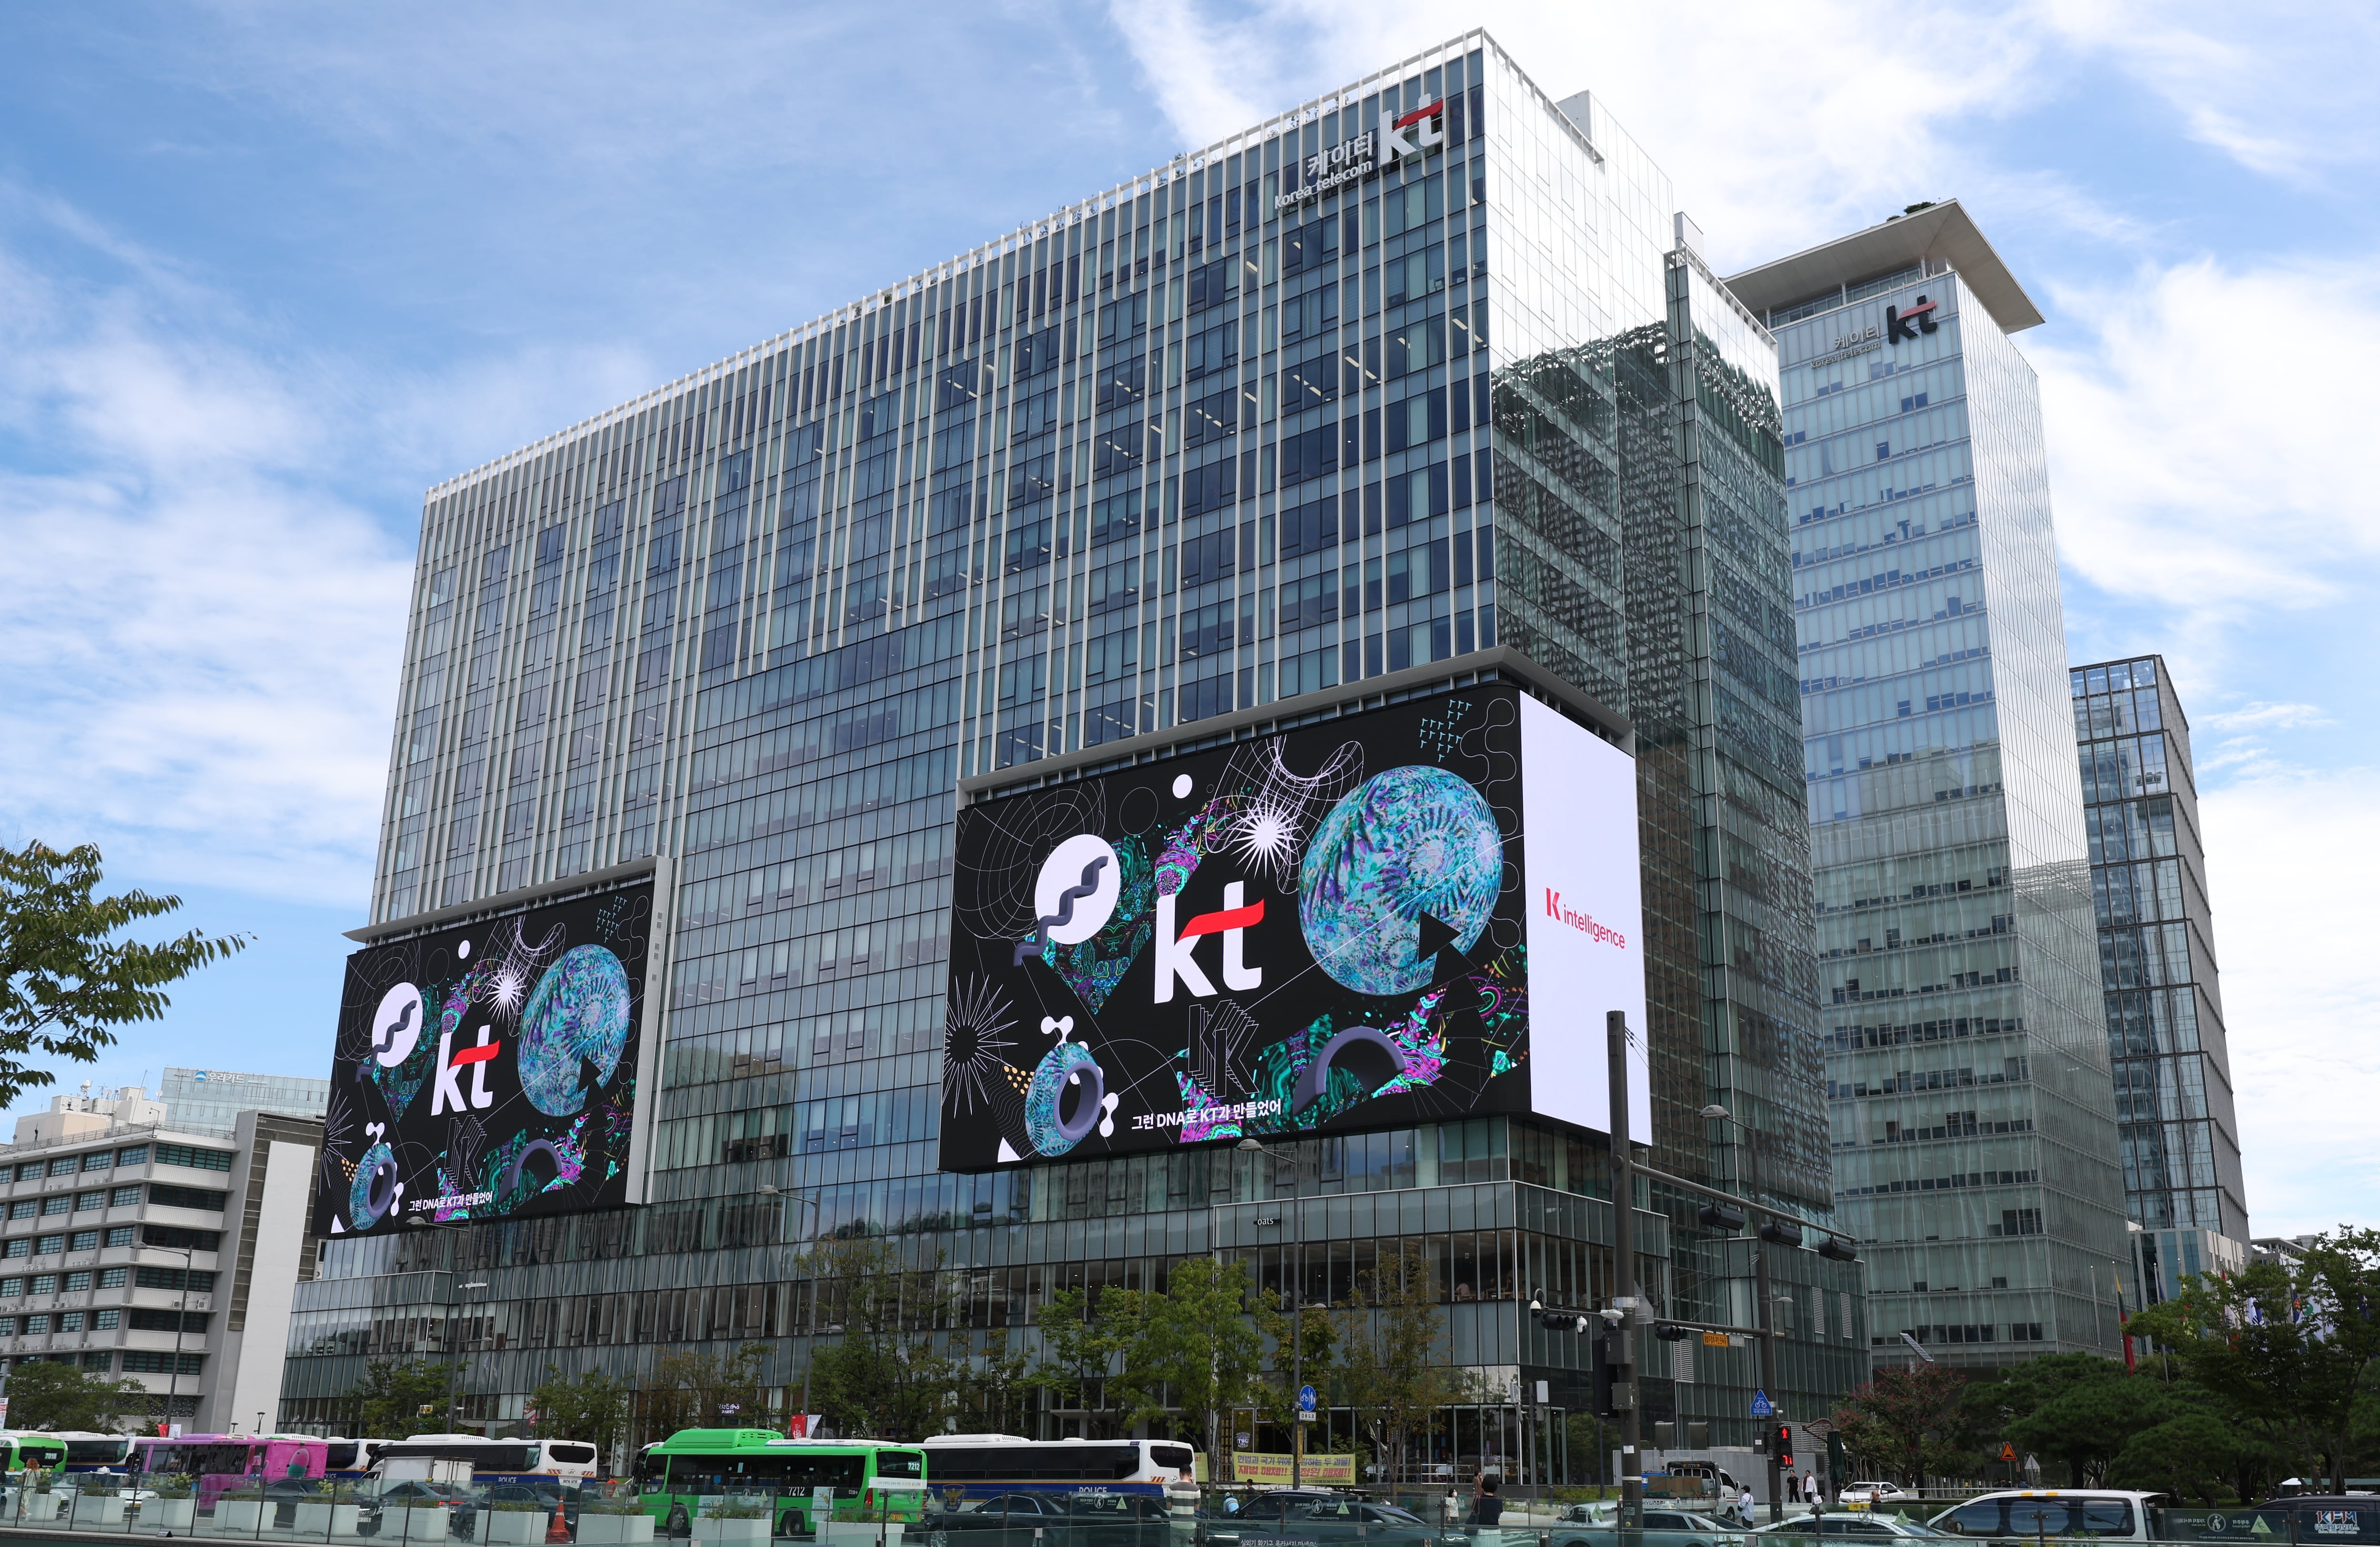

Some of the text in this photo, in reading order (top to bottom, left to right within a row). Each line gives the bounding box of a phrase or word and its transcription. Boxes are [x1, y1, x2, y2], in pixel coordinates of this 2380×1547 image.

[1379, 93, 1444, 167] kt
[1308, 131, 1372, 177] 케이티
[1275, 161, 1372, 209] korea telecom
[1886, 295, 1938, 345] kt
[1834, 323, 1880, 349] 케이티
[1810, 342, 1881, 369] korea telecom
[1546, 887, 1625, 949] K intelligence
[1154, 880, 1265, 1005] kt
[208, 1072, 245, 1084] 우리카드
[431, 1024, 500, 1116] kt
[1131, 1098, 1281, 1130] 그런 DNA로 KT가 만들었어
[408, 1191, 493, 1212] 그런 DNA로 KT가 만들었어
[1258, 1217, 1274, 1225] oats
[1237, 1455, 1259, 1464] 헌법과
[1260, 1456, 1275, 1465] 국가
[1277, 1457, 1292, 1465] 위에
[1324, 1458, 1331, 1466] 두
[1333, 1457, 1351, 1466] 괴물!
[1238, 1465, 1351, 1478] 재벌 해체!! 정원 해체!!
[788, 1486, 805, 1496] 7212
